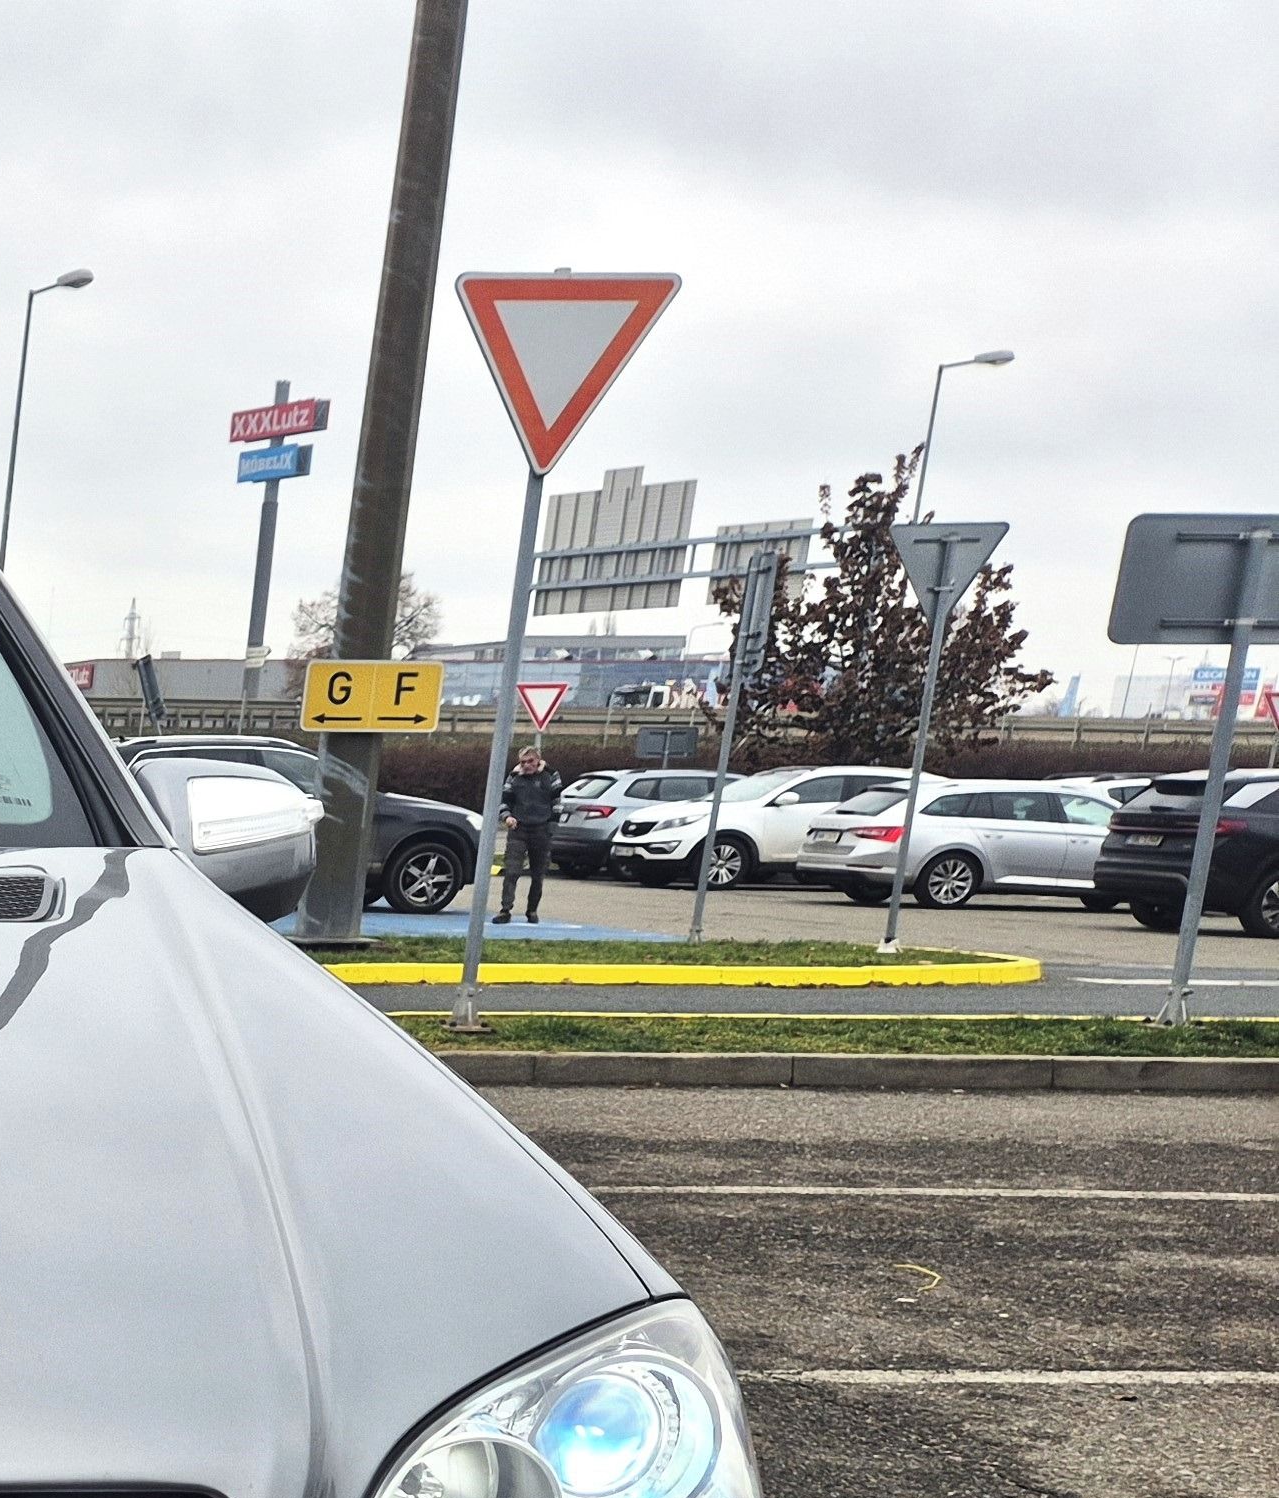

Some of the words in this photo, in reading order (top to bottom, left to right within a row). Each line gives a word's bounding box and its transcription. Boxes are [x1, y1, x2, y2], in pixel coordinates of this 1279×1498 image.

[232, 406, 309, 437] XXXLutz
[327, 671, 353, 705] G
[394, 672, 419, 705] F
